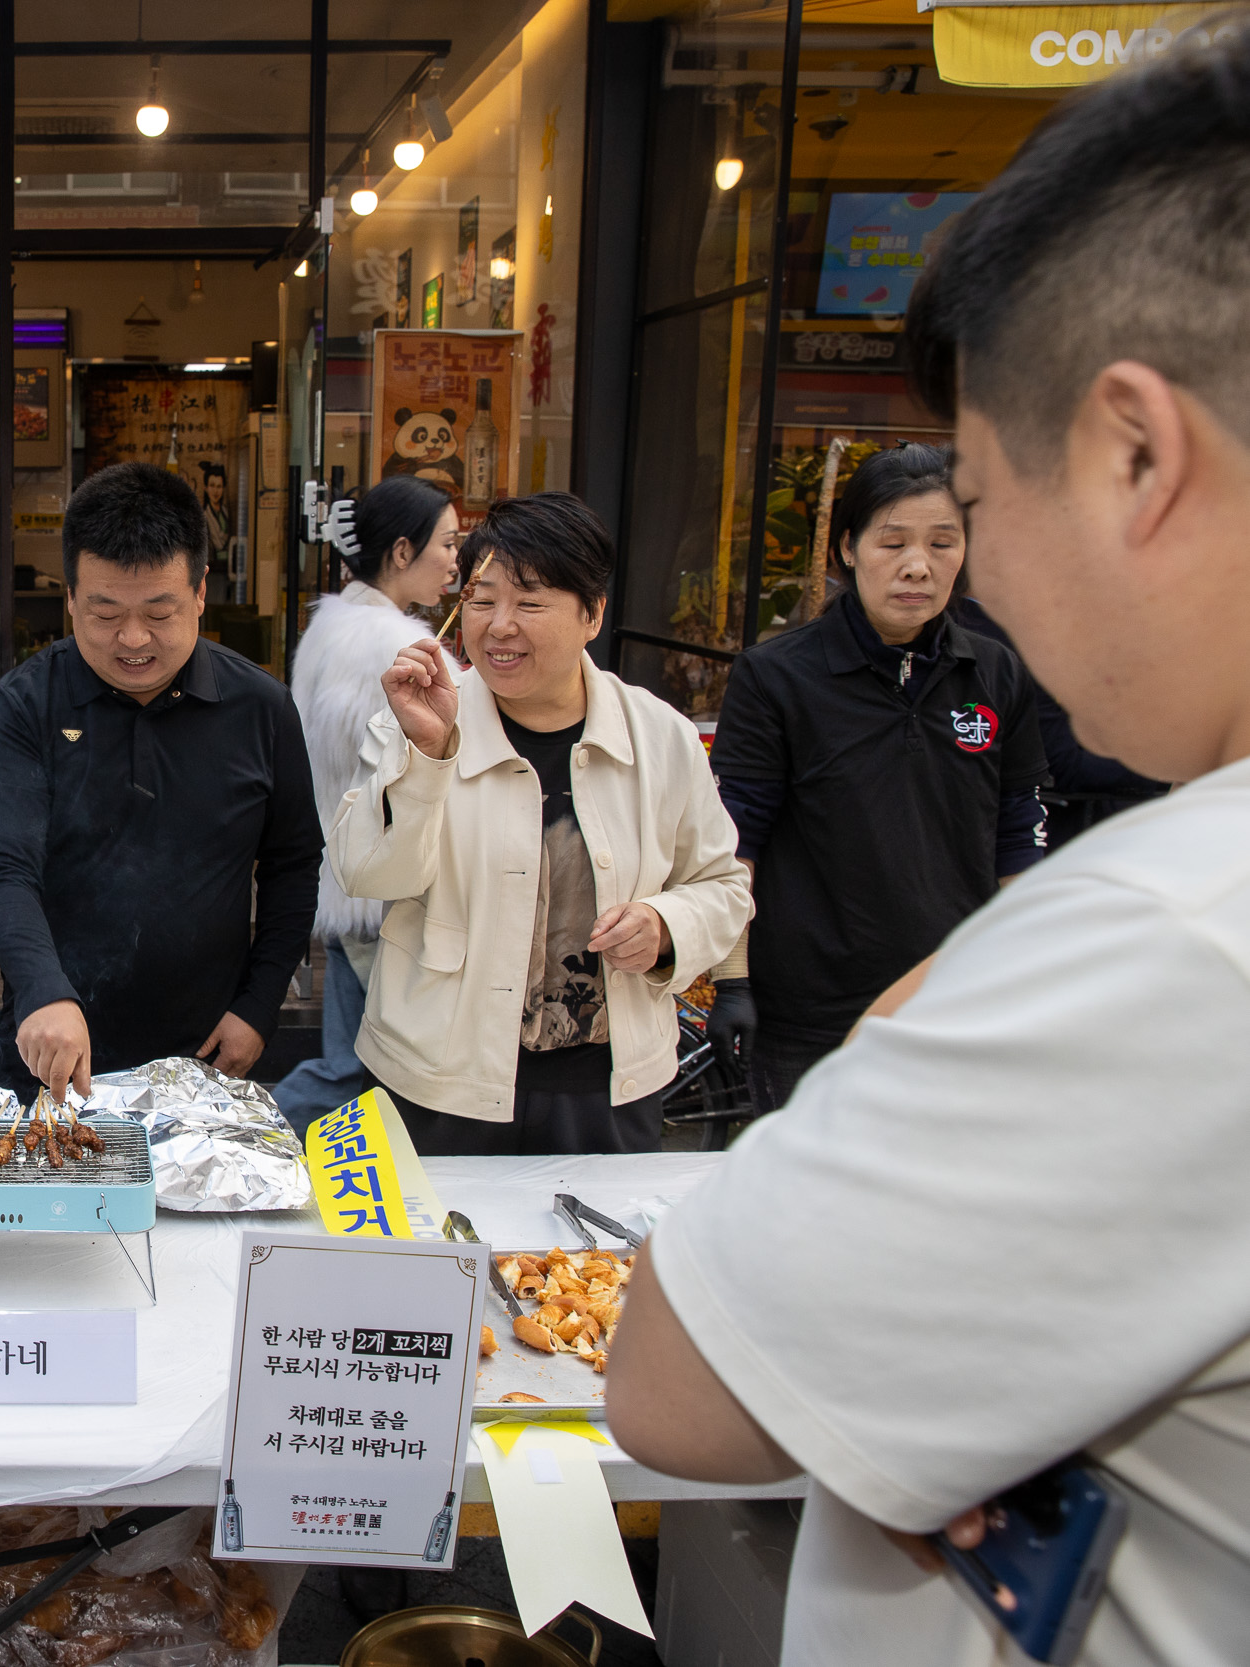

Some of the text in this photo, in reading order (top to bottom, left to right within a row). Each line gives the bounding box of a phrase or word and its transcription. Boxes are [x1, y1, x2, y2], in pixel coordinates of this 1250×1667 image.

[393, 341, 504, 373] 노주노교
[419, 374, 470, 405] 블랙
[261, 1325, 448, 1357] 한 사람 당 2개 꼬치씩
[263, 1355, 441, 1386] 무료시식 가능합니다
[288, 1404, 408, 1431] 차례대로 줄을
[263, 1432, 427, 1460] 서 주시길 바랍니다
[290, 1494, 387, 1508] 중국 4대명주 노주노교
